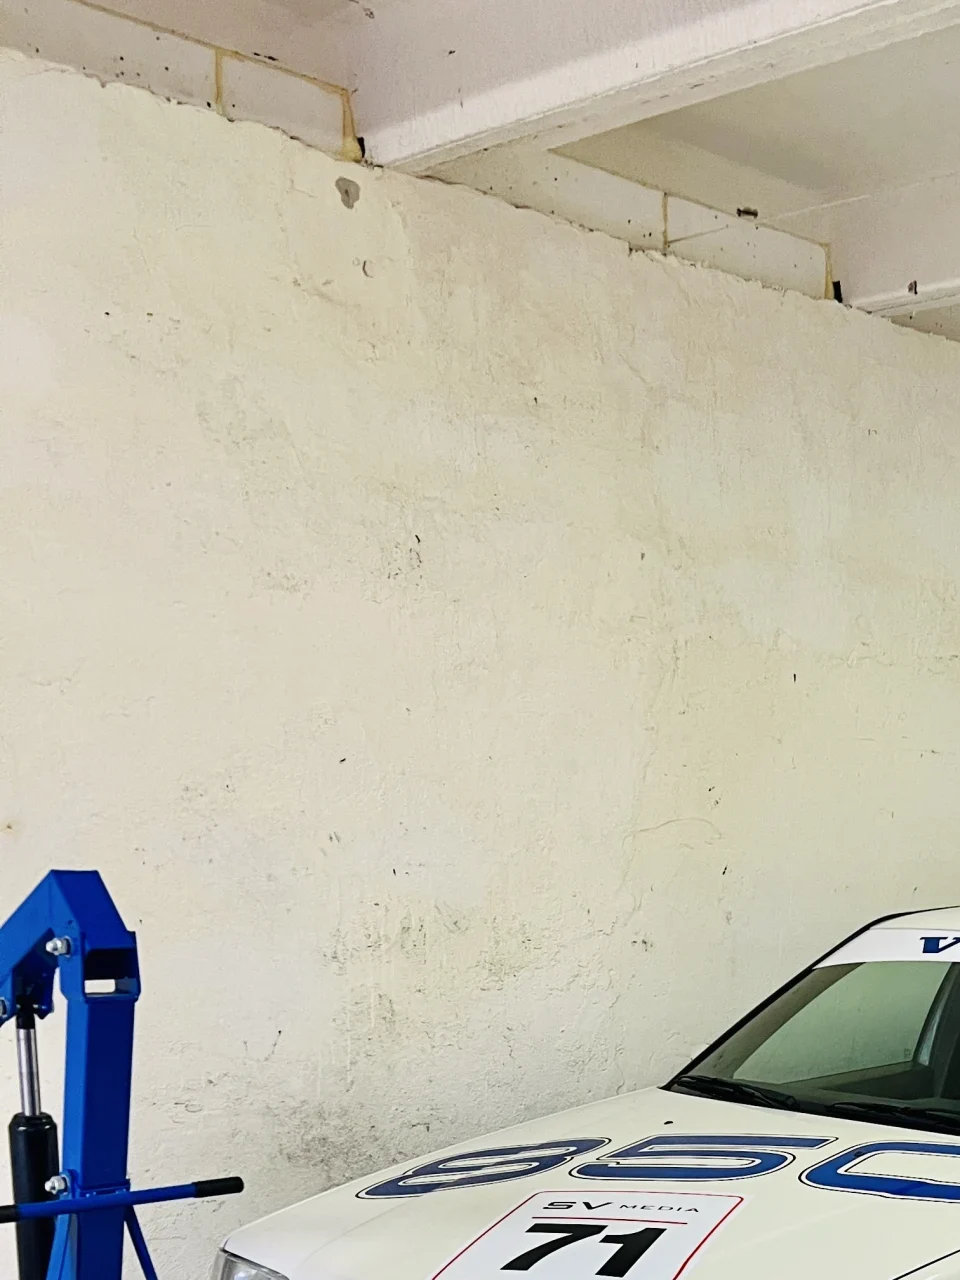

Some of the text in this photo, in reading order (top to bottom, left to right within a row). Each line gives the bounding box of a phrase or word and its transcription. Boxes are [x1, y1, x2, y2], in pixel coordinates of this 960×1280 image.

[543, 1201, 700, 1213] SV MEDIA
[500, 1223, 668, 1278] 71
